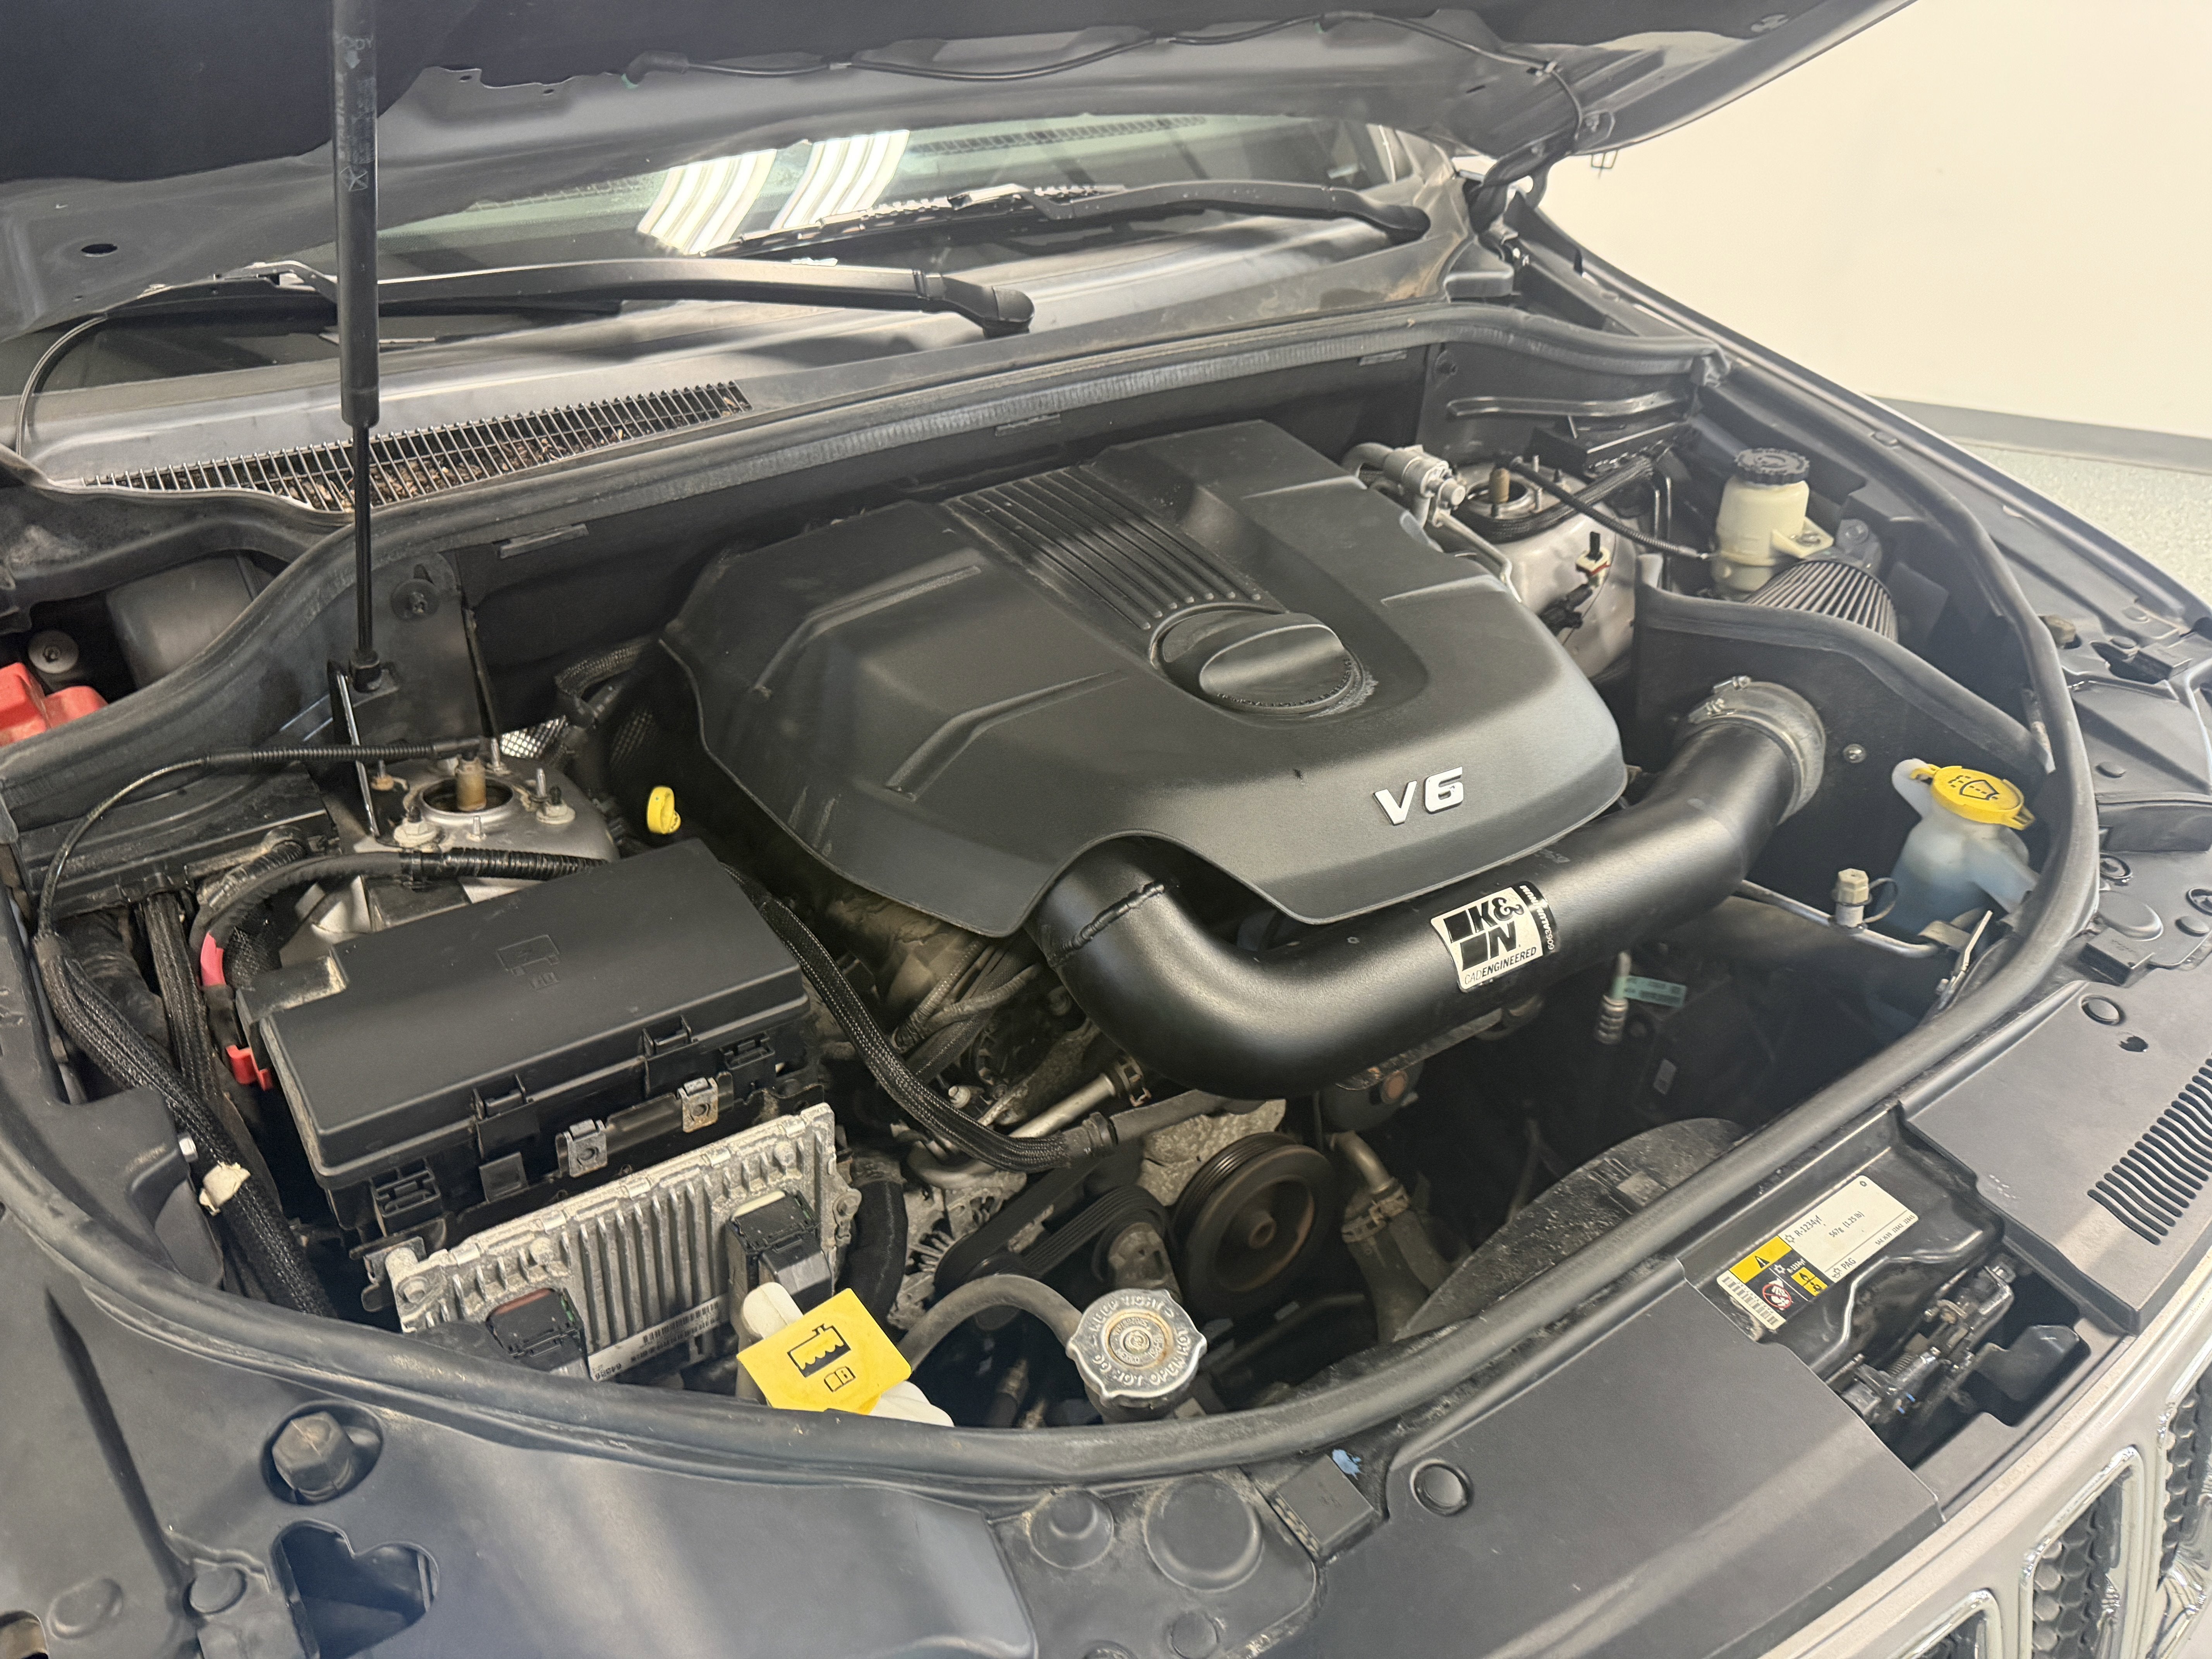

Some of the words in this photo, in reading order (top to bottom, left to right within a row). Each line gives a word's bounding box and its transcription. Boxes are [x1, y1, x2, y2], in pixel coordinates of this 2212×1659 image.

[1373, 766, 1464, 826] V6
[1794, 1215, 1822, 1237] R-1234yf
[1829, 1227, 1844, 1238] 567g
[1842, 1216, 1857, 1228] (1.25
[1855, 1211, 1865, 1219] lb)
[1841, 1257, 1856, 1270] PAG
